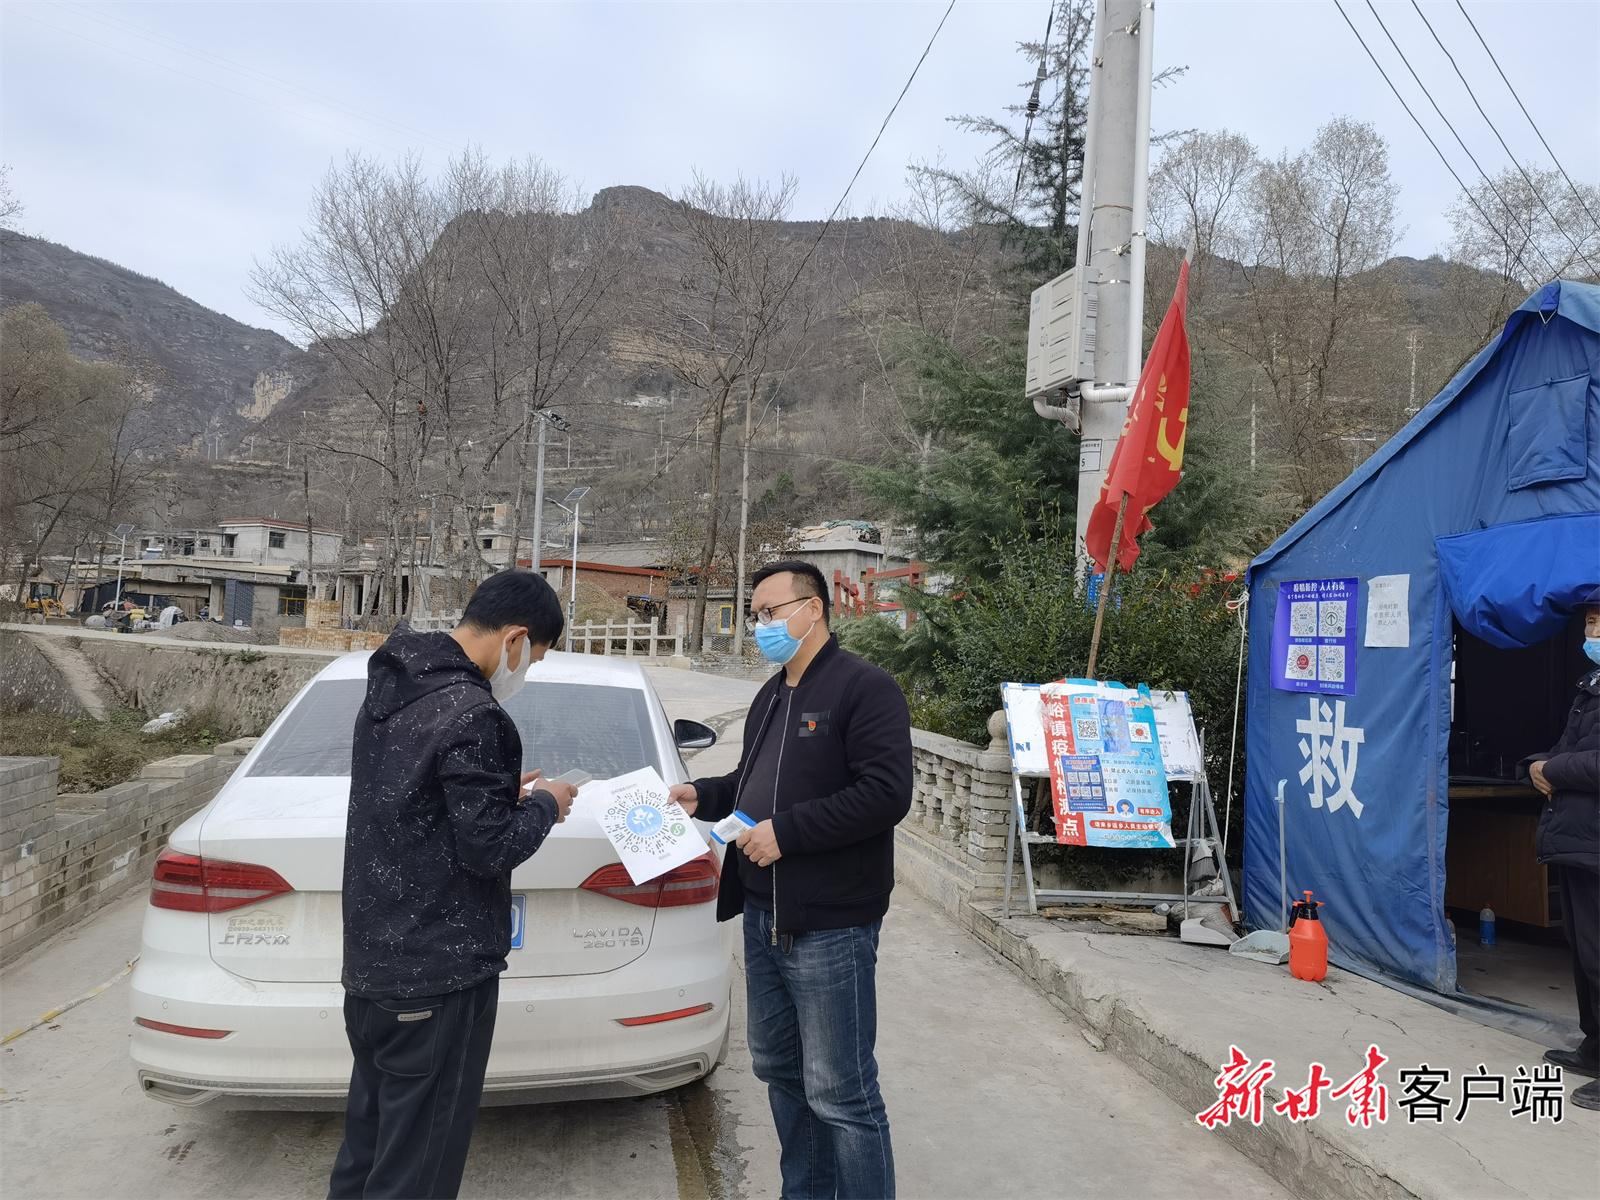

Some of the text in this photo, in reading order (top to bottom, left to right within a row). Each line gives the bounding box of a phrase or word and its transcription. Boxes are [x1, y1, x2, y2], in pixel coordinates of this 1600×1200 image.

[1296, 697, 1365, 819] 救
[218, 932, 291, 945] 上汽大众
[573, 927, 643, 938] LAVIDA
